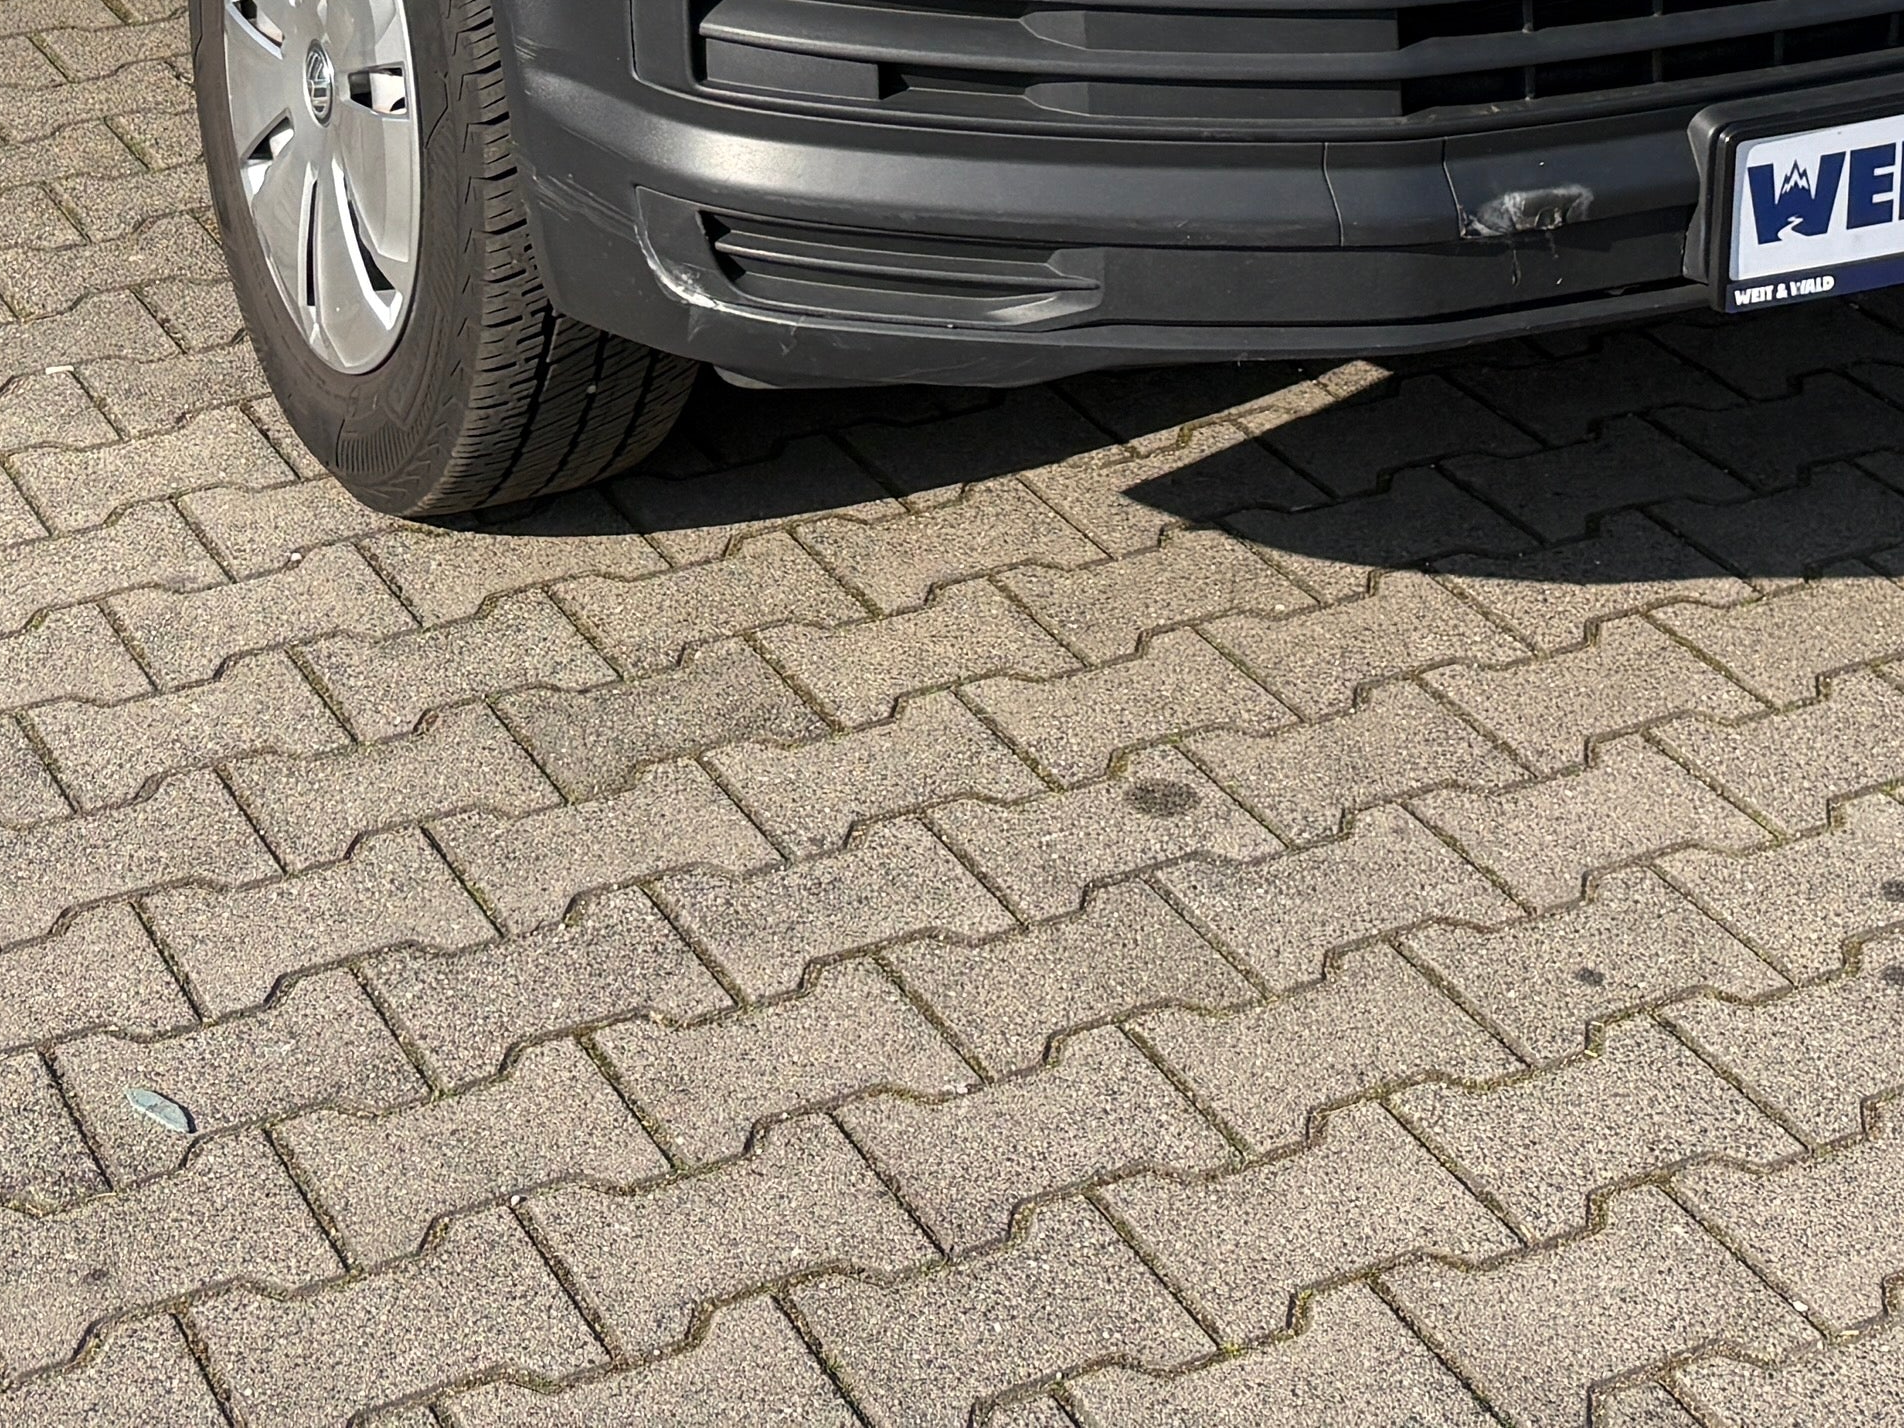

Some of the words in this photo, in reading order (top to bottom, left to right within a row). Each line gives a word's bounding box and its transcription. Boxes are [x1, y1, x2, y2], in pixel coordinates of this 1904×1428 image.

[1734, 285, 1775, 306] WEIT
[1775, 283, 1788, 299] &
[1789, 275, 1835, 297] WALD
